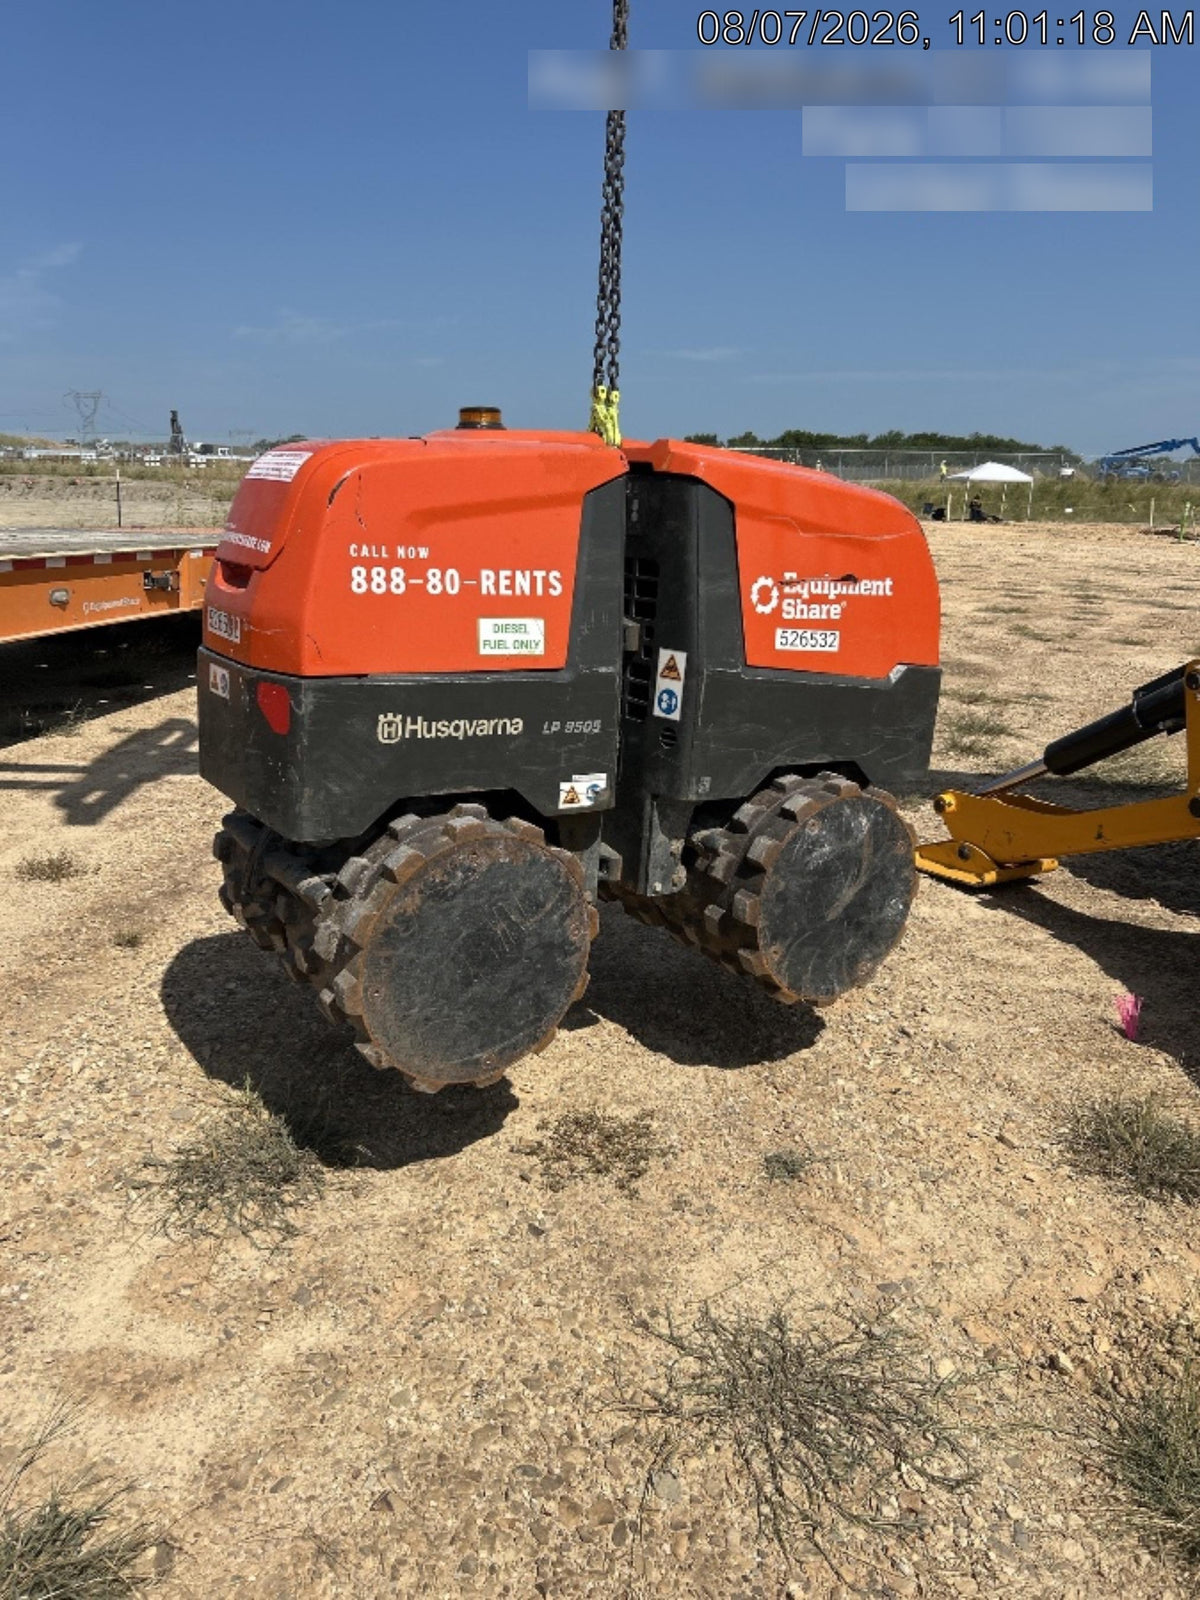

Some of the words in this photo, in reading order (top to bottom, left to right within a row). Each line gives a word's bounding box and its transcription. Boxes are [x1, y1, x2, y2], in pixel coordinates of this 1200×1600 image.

[349, 543, 389, 559] CALL
[397, 545, 430, 560] NOW
[350, 565, 563, 597] 888-80-RENTS
[783, 572, 893, 599] Equipment
[492, 623, 530, 635] DIESEL
[482, 640, 509, 650] FUEL
[512, 639, 542, 651] ONLY
[779, 630, 838, 648] 526532
[404, 715, 524, 741] Husqvarna
[542, 720, 561, 735] LP
